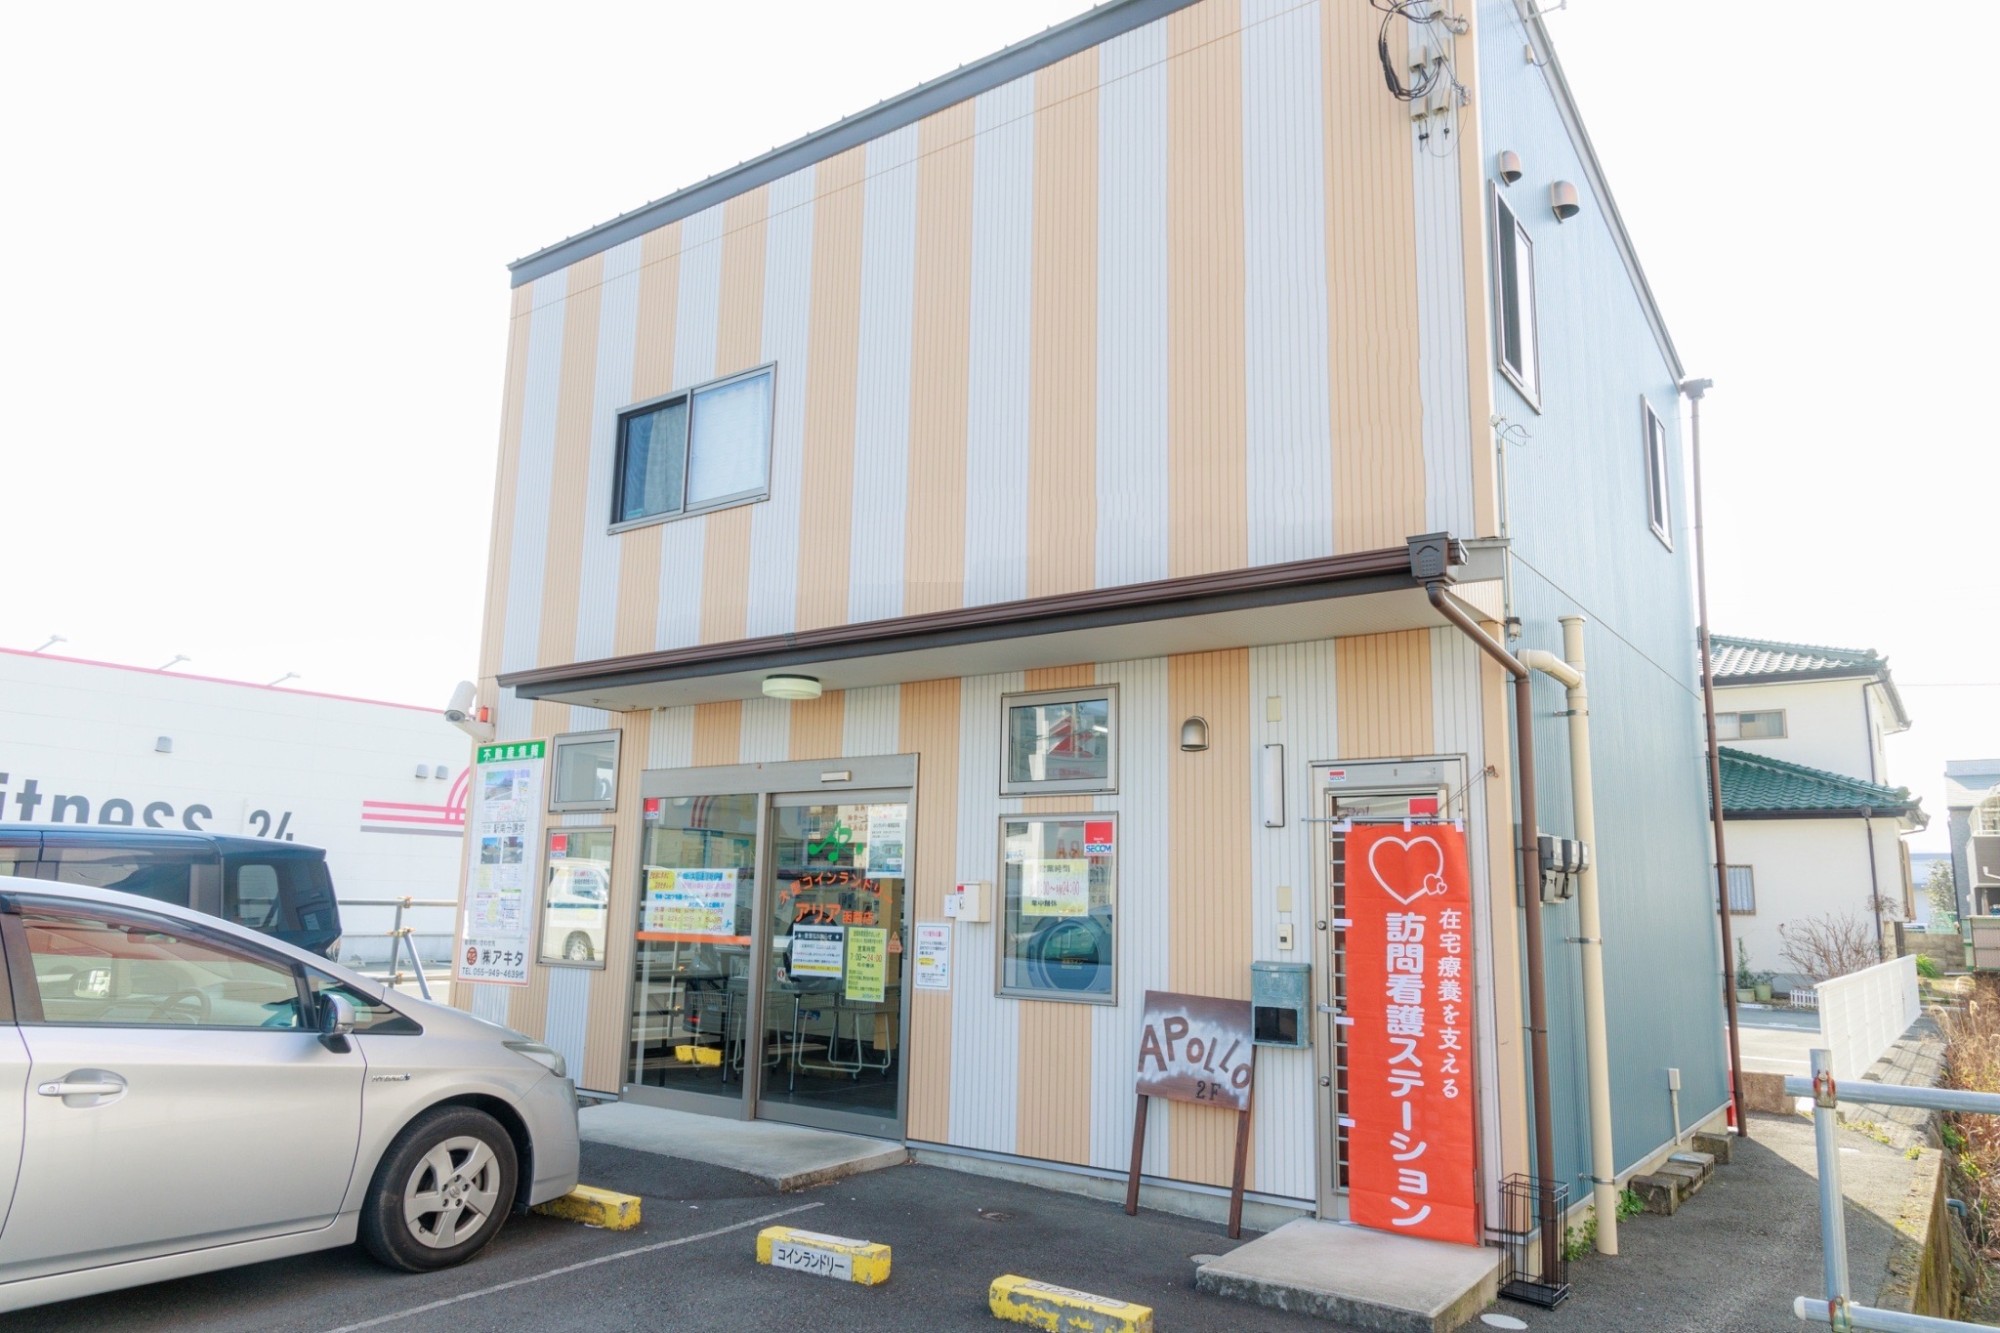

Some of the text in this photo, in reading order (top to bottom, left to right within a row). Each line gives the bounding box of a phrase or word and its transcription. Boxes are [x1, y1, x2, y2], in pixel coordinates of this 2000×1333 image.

[249, 809, 294, 841] 24
[1086, 844, 1112, 853] SECOM
[795, 903, 842, 924] アリア
[462, 967, 473, 976] TEL
[1437, 907, 1463, 1099] 在宅療養を支える
[1385, 911, 1431, 1227] 訪問看護ステーション
[1195, 1080, 1222, 1101] 2F
[777, 1248, 845, 1273] コインランドリー
